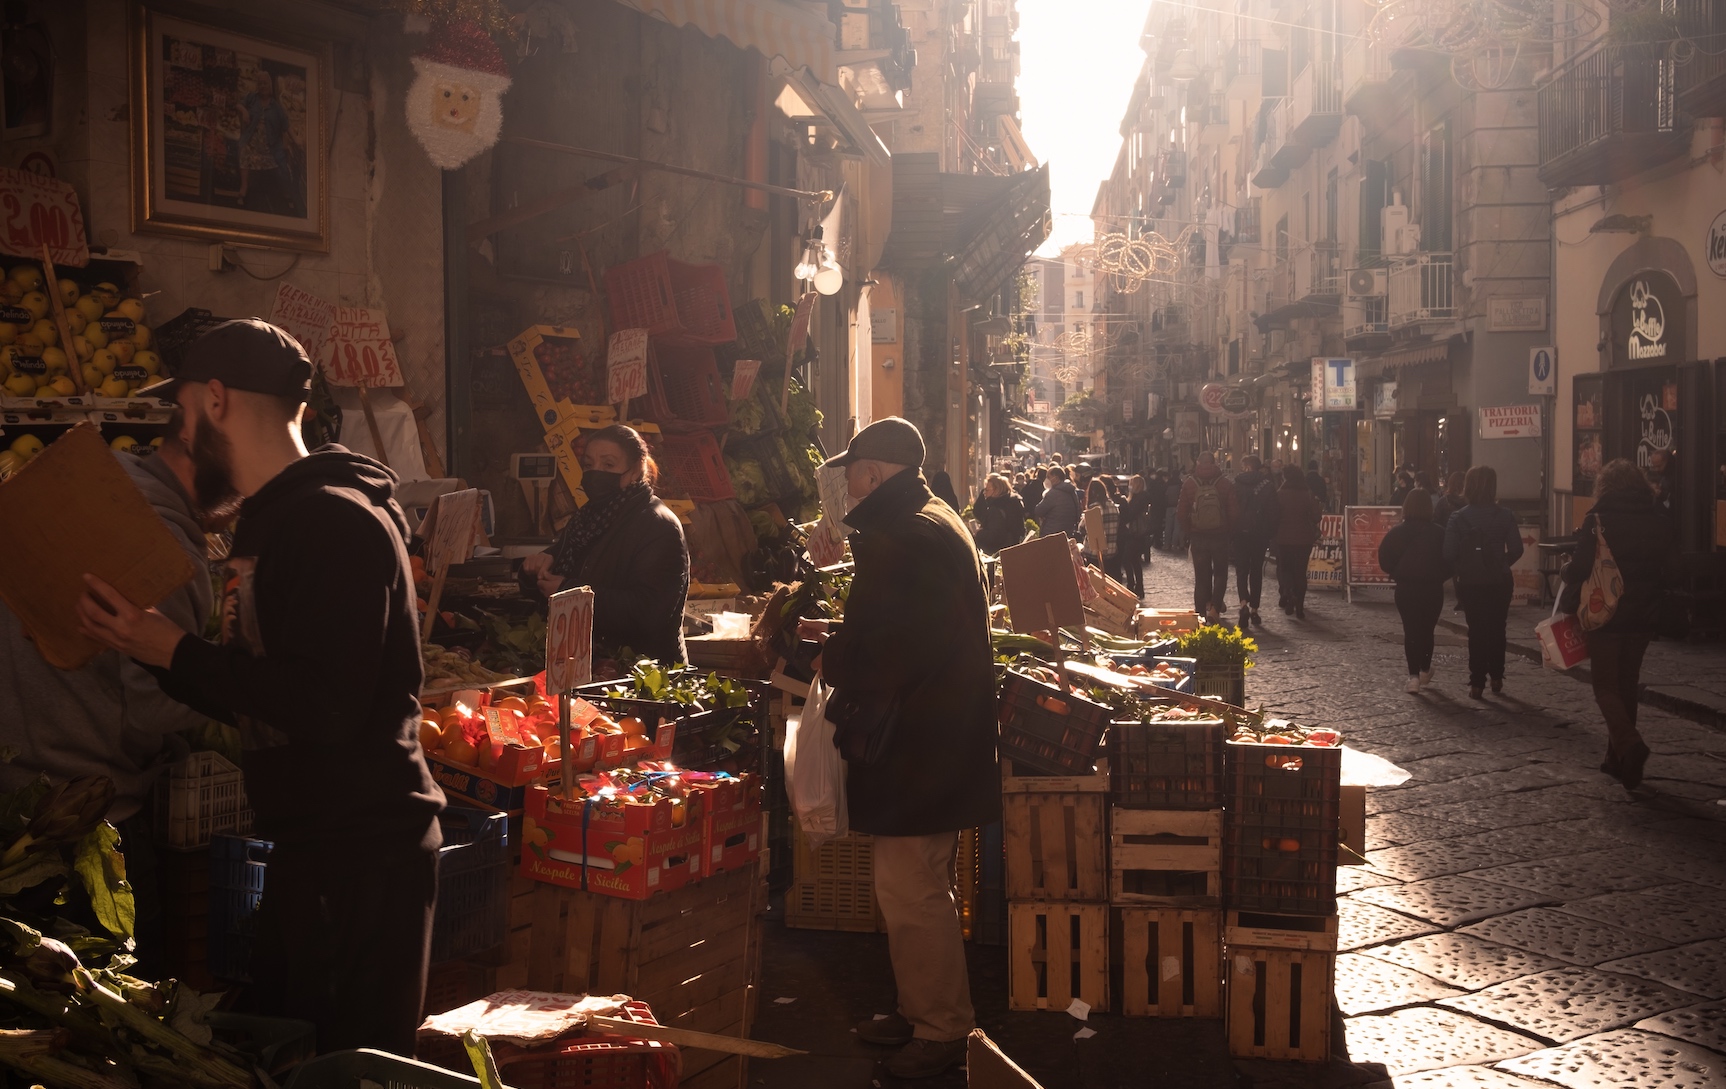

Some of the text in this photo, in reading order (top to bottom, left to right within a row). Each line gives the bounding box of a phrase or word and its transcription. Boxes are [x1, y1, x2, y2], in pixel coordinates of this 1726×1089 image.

[1328, 360, 1351, 386] T
[1483, 405, 1539, 418] TRATTORIA
[1489, 416, 1534, 428] PIZZERIA
[1330, 571, 1342, 581] FRE
[563, 802, 581, 810] FRUTTA
[649, 836, 676, 856] Nespole
[529, 860, 575, 881] Nespole
[594, 873, 631, 892] Sicilia
